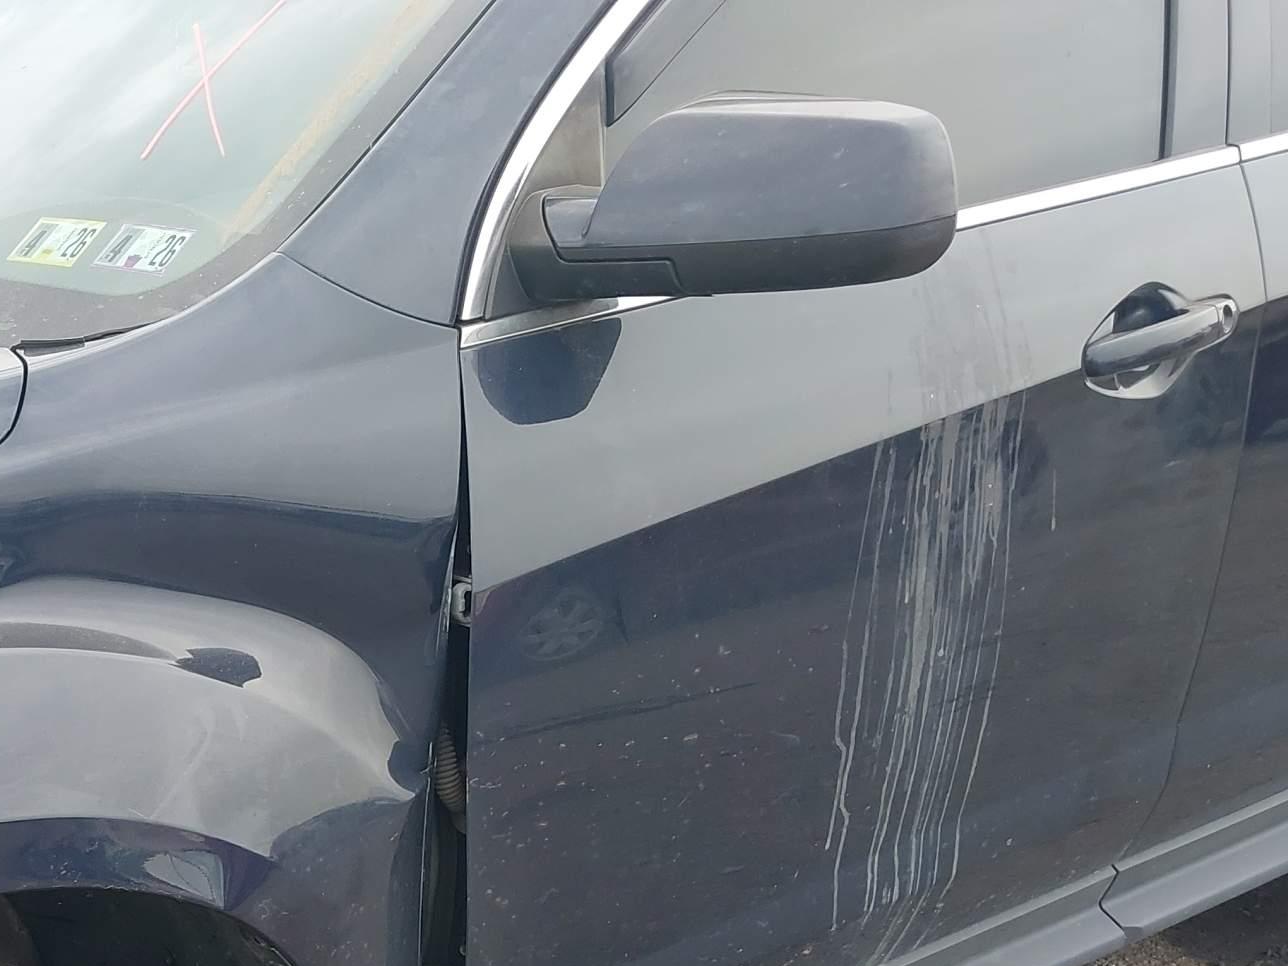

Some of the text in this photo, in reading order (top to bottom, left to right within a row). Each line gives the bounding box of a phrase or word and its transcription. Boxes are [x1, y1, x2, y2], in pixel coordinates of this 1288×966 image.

[23, 230, 48, 256] 4
[60, 228, 97, 259] 26
[104, 234, 134, 263] 4
[148, 234, 187, 268] 26
